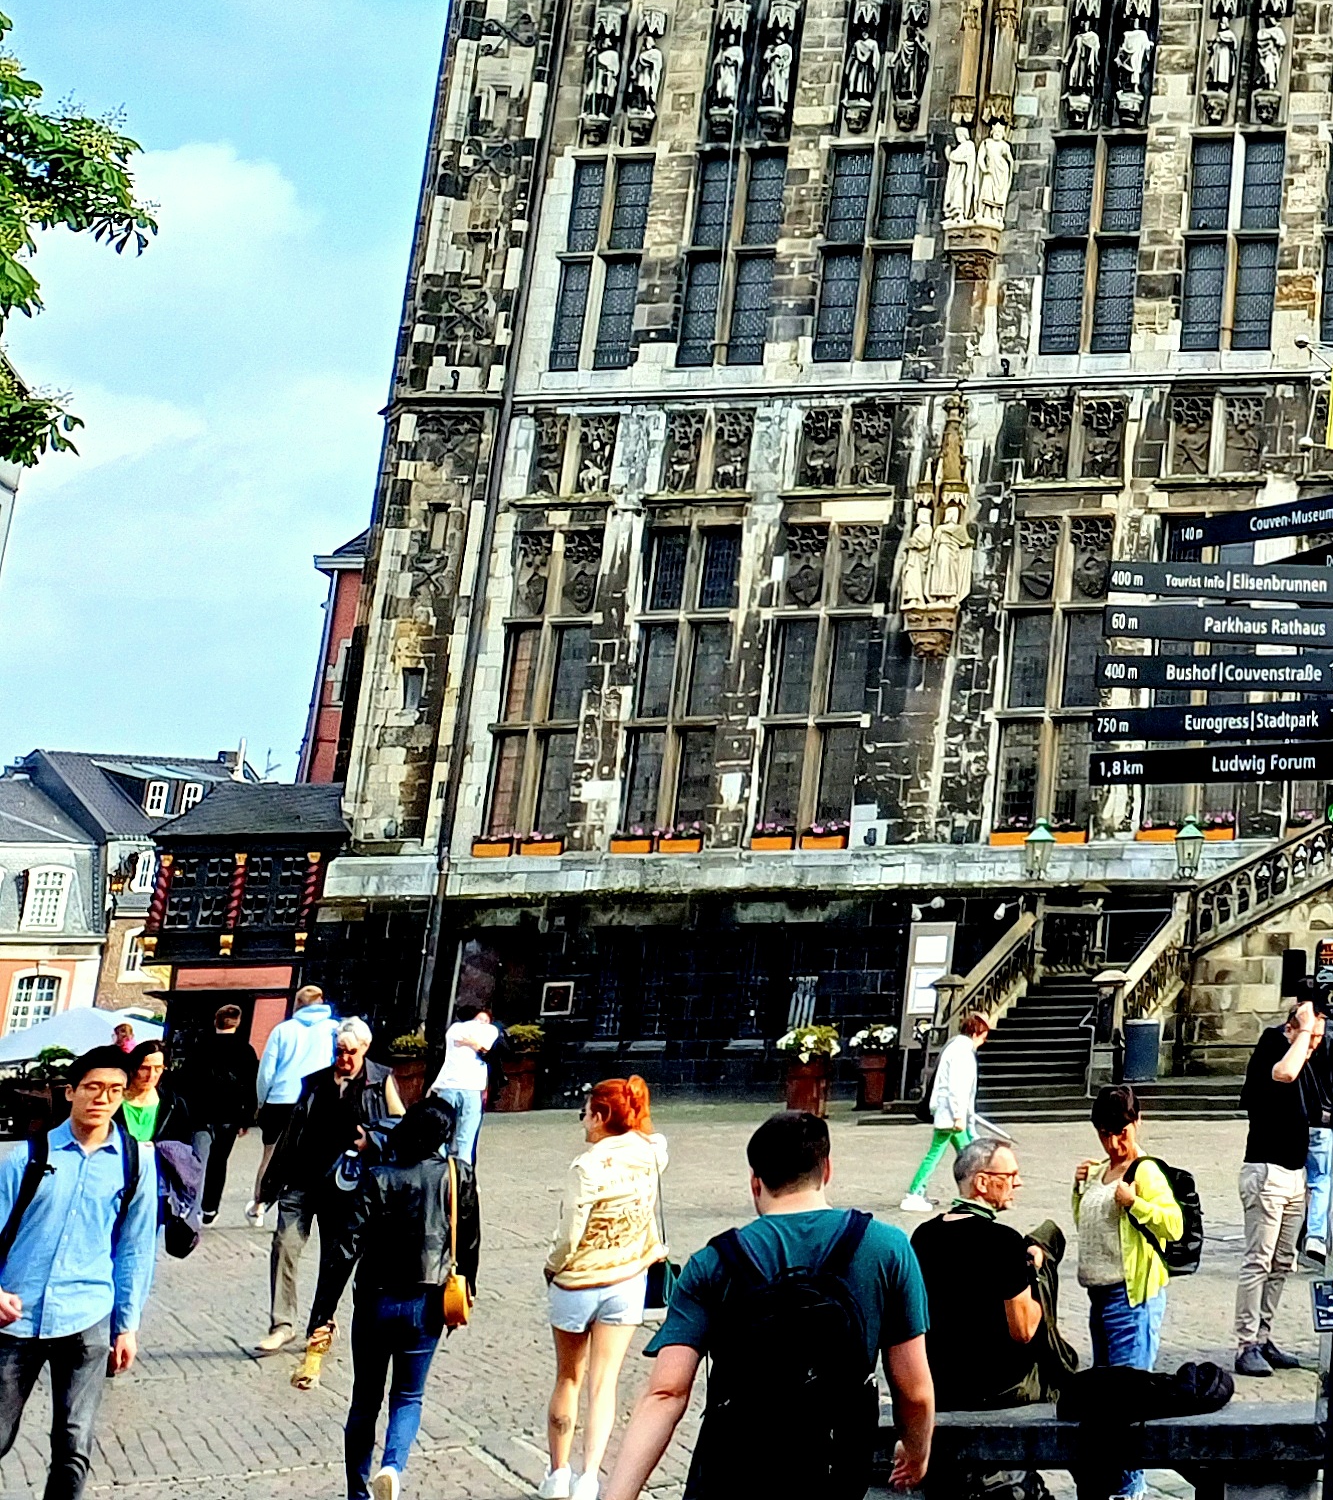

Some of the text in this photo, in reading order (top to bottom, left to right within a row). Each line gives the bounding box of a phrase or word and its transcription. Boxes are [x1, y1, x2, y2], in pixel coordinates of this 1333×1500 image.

[1181, 527, 1195, 542] 140
[1195, 528, 1204, 539] m
[1111, 571, 1132, 587] 400
[1133, 575, 1144, 587] m
[1165, 573, 1201, 588] Tourist
[1111, 613, 1127, 630] 60
[1128, 617, 1138, 630] m
[1204, 616, 1268, 635] Parkhaus
[1271, 618, 1326, 636] Rathaus
[1104, 663, 1126, 680] 400
[1127, 666, 1138, 680] m
[1097, 717, 1117, 733] 750
[1118, 721, 1129, 733] m
[1211, 754, 1266, 775] Ludwig
[1270, 753, 1316, 771] Forum
